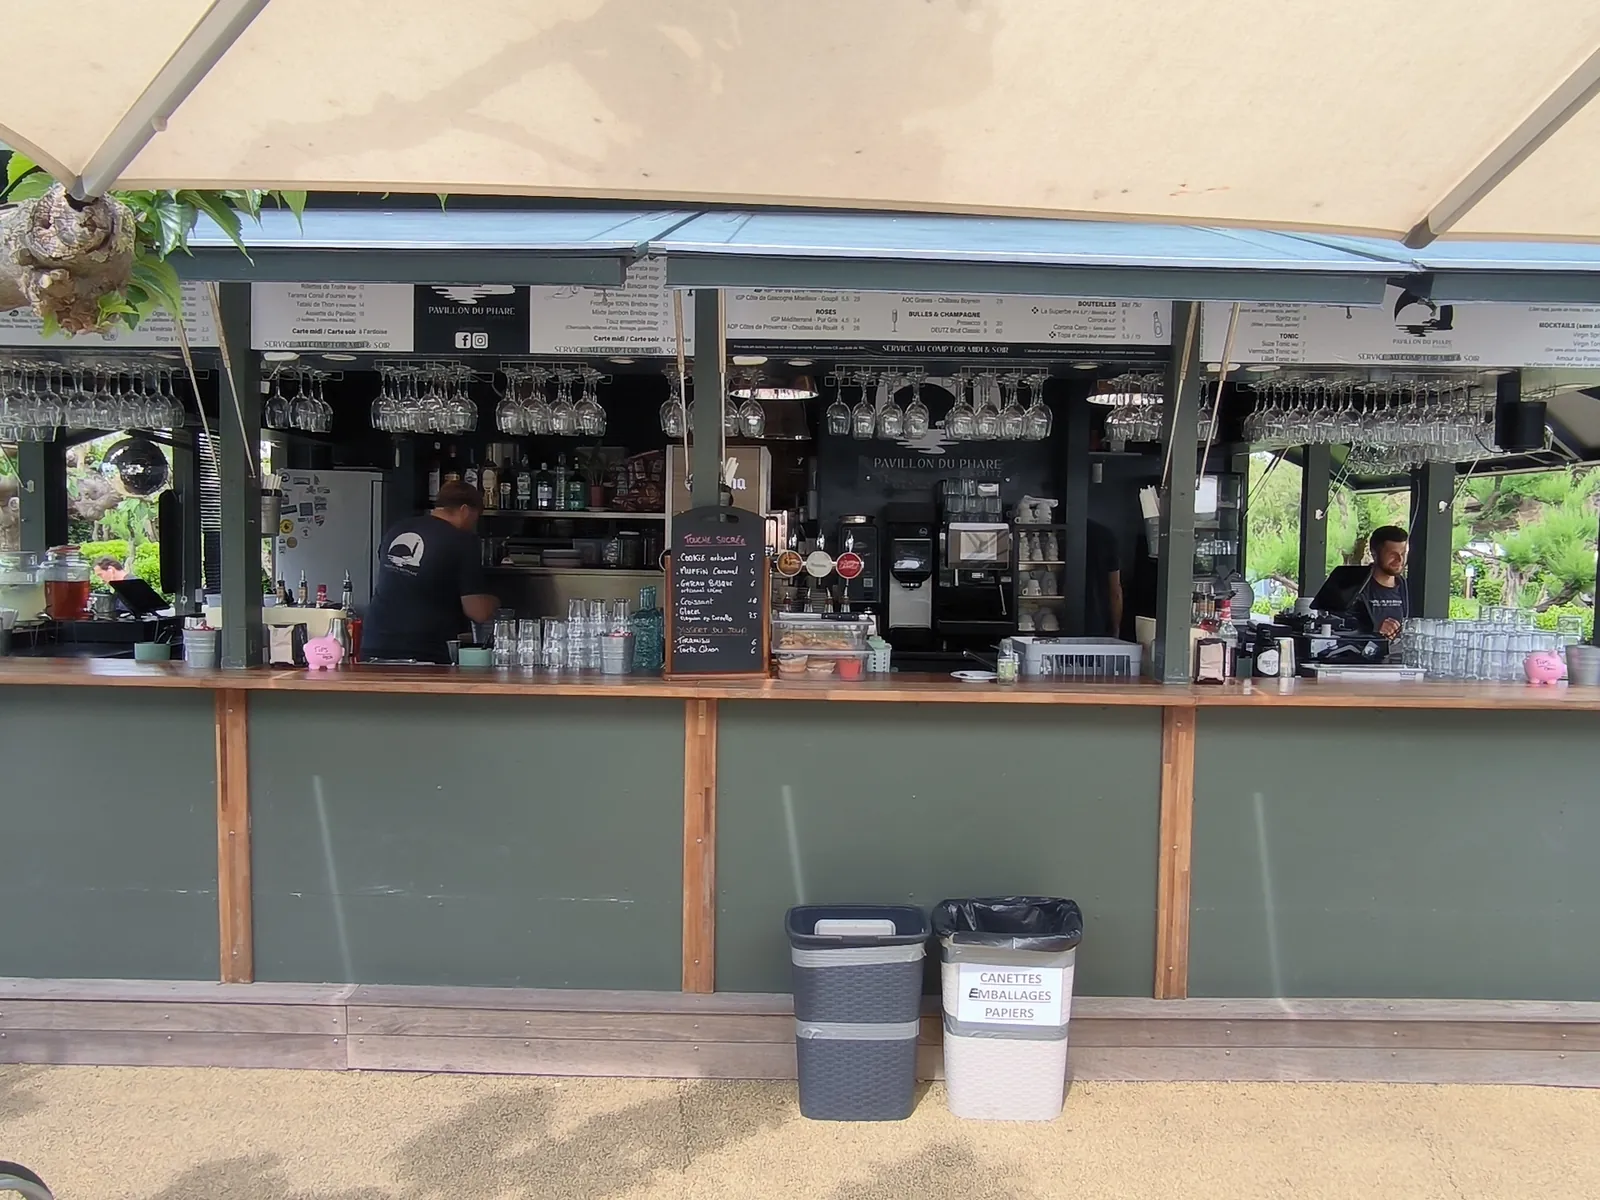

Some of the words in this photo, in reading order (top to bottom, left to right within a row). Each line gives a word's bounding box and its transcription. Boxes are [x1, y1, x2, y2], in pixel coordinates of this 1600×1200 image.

[428, 306, 470, 315] PAVILLON
[472, 306, 484, 315] DU
[486, 307, 515, 315] PHARE
[914, 345, 925, 353] AU
[927, 345, 966, 353] COMPTOIR
[967, 345, 982, 353] MIDI
[874, 458, 935, 468] PAVILLON
[939, 458, 955, 468] DU
[960, 459, 1002, 470] PHARE
[680, 597, 714, 605] Croissant
[980, 972, 1042, 984] CANETTES
[969, 988, 1051, 1000] EMBALLAGES
[985, 1007, 1034, 1018] PAPIERS
